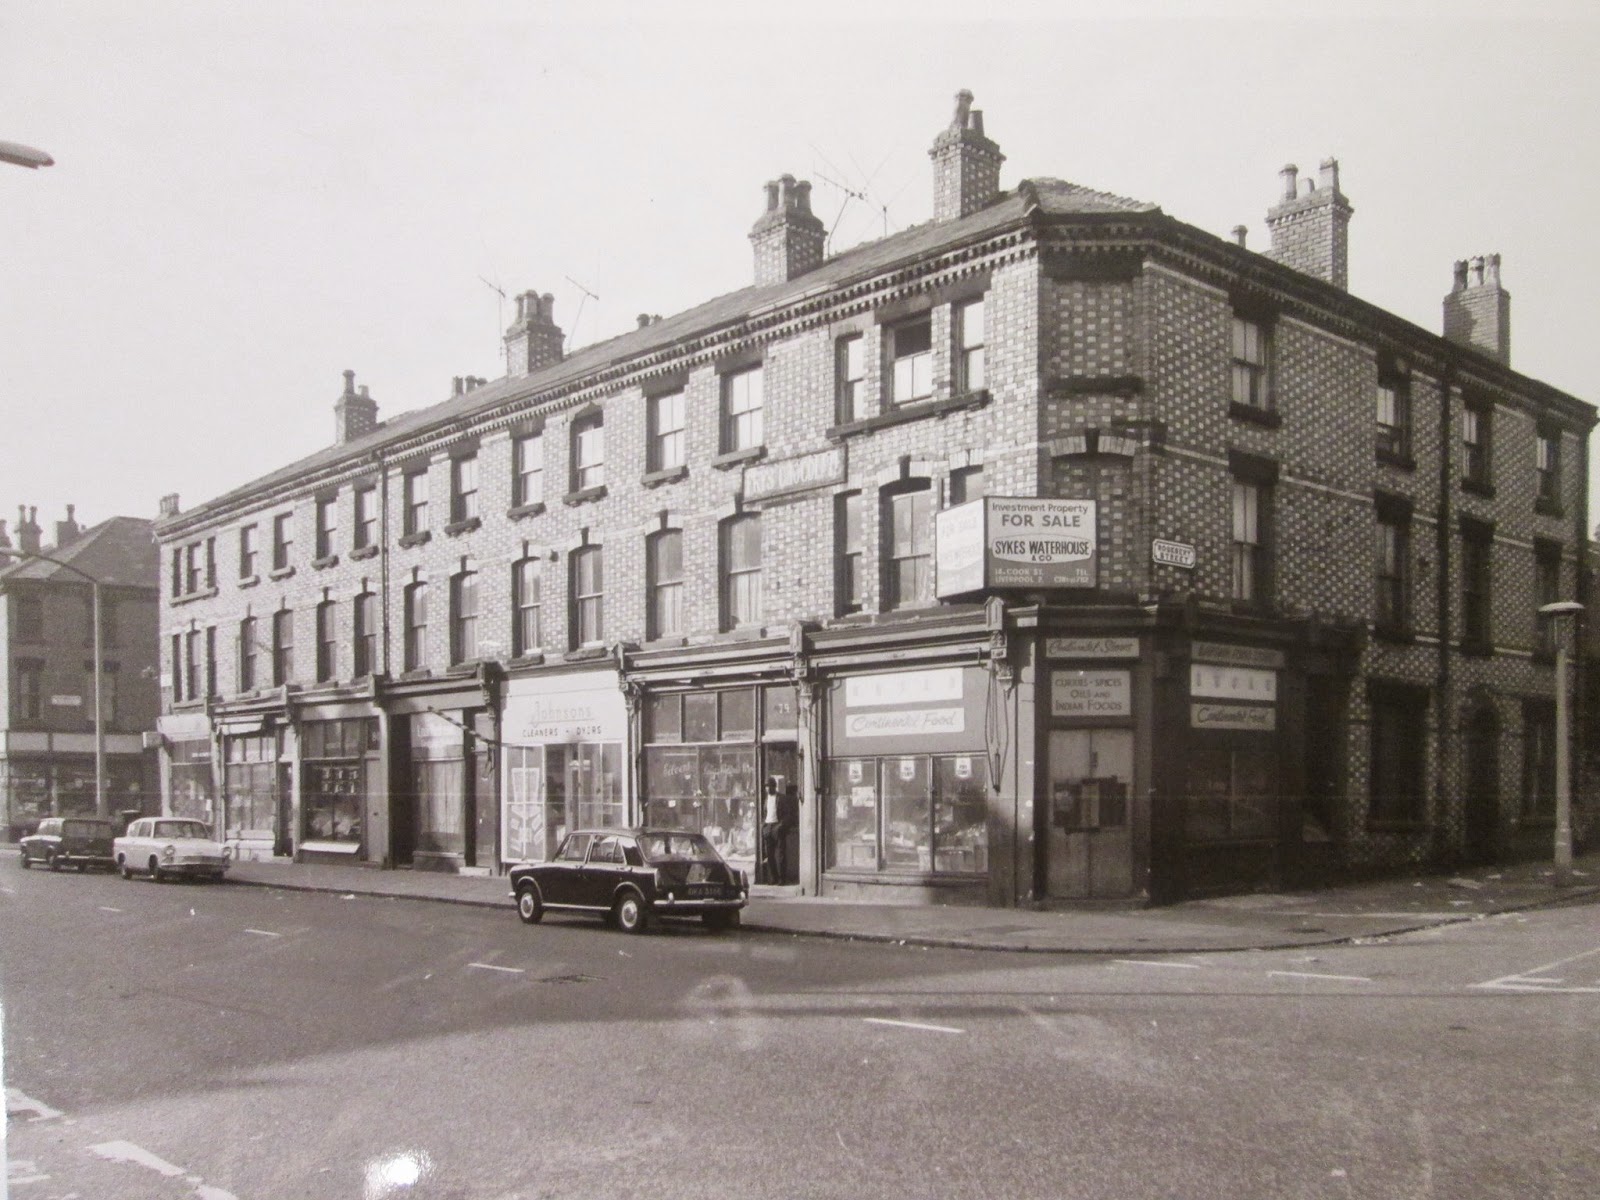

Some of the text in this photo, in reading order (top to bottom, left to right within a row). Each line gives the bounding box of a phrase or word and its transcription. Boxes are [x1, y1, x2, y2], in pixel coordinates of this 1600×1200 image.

[992, 503, 1088, 515] Investment Property
[1001, 514, 1081, 528] FOR SALE
[995, 540, 1090, 555] SYKES WATERHOUSE
[1160, 552, 1189, 563] STREET
[1088, 700, 1122, 711] FOODS
[851, 711, 957, 732] Continental Food
[522, 727, 559, 738] CLEANERS
[576, 725, 602, 736] DYERS
